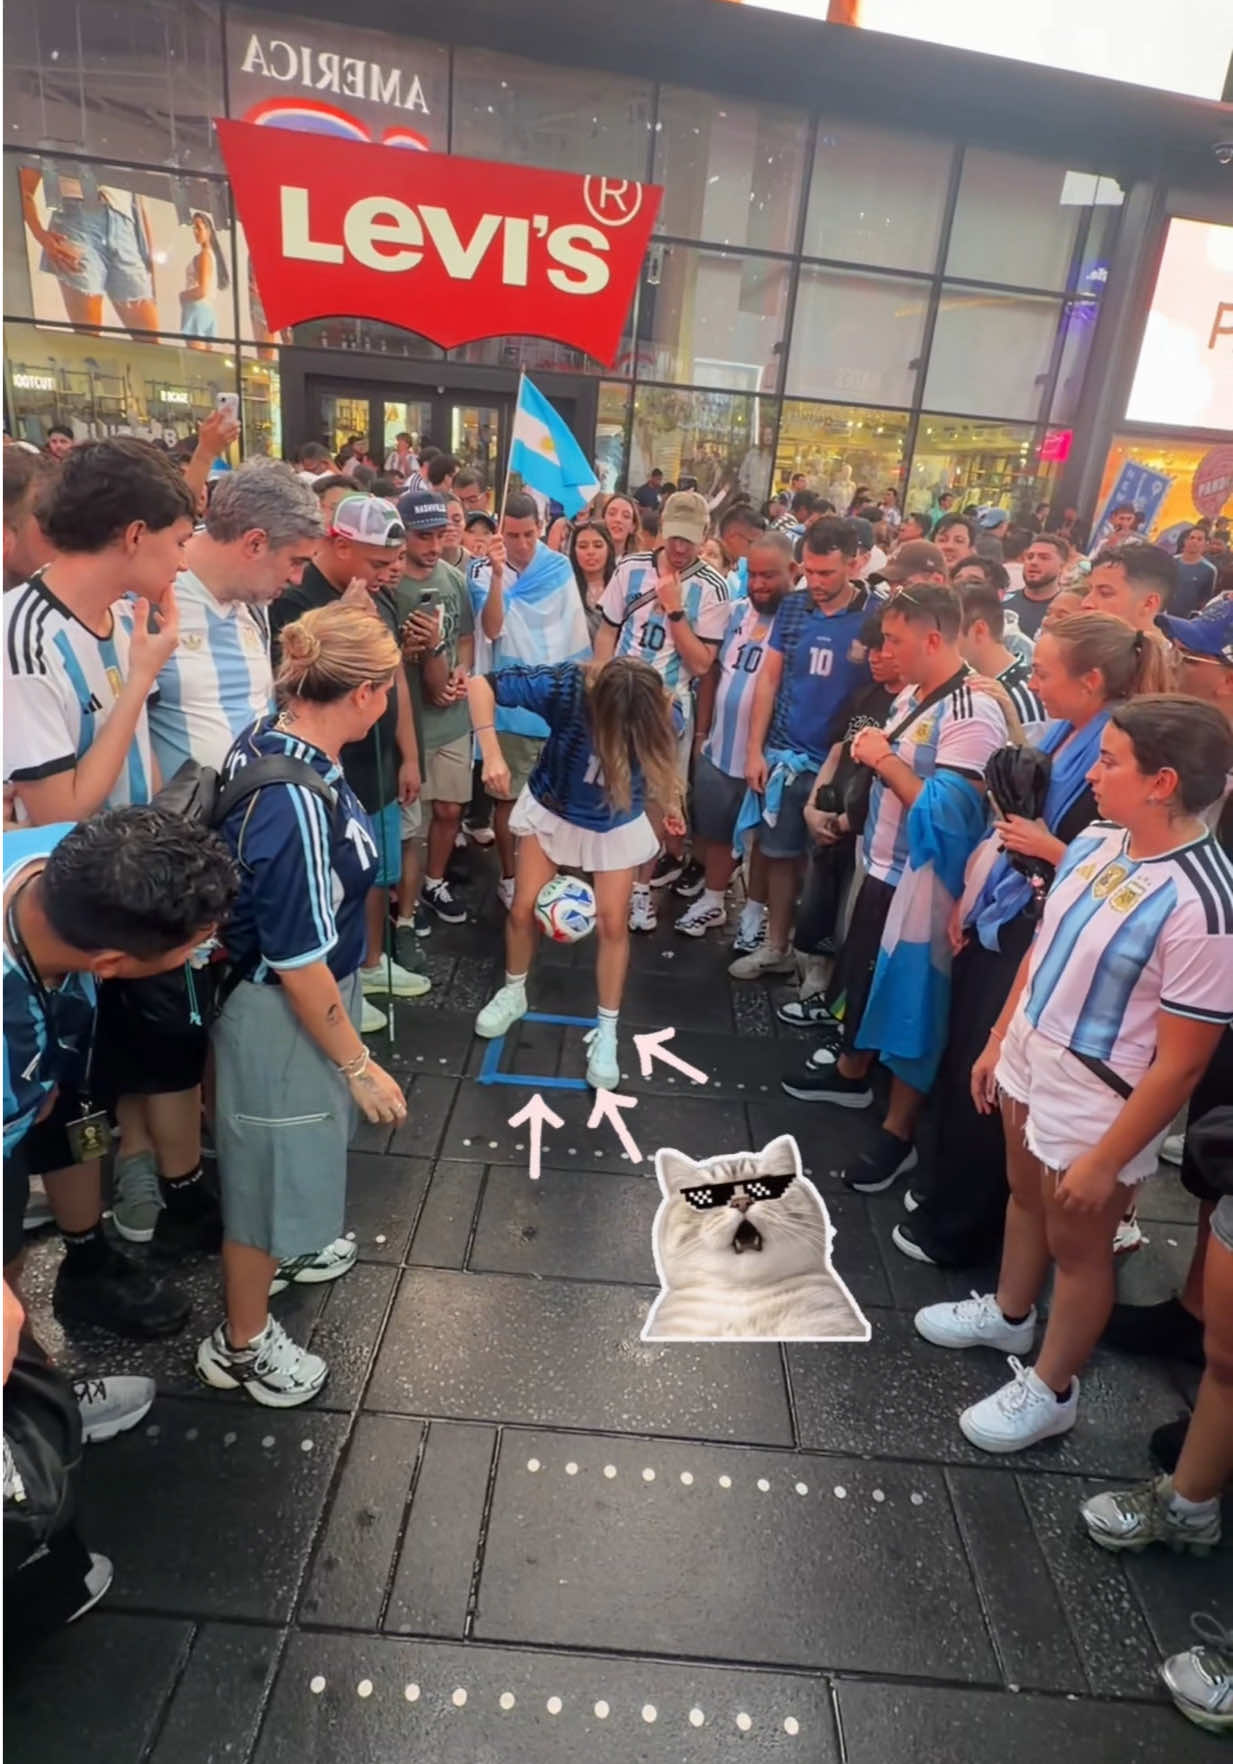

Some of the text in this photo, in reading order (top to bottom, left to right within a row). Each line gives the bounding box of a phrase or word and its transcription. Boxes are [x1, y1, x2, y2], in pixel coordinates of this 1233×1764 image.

[638, 620, 667, 651] 10
[731, 643, 763, 673] 10
[808, 646, 834, 677] 10
